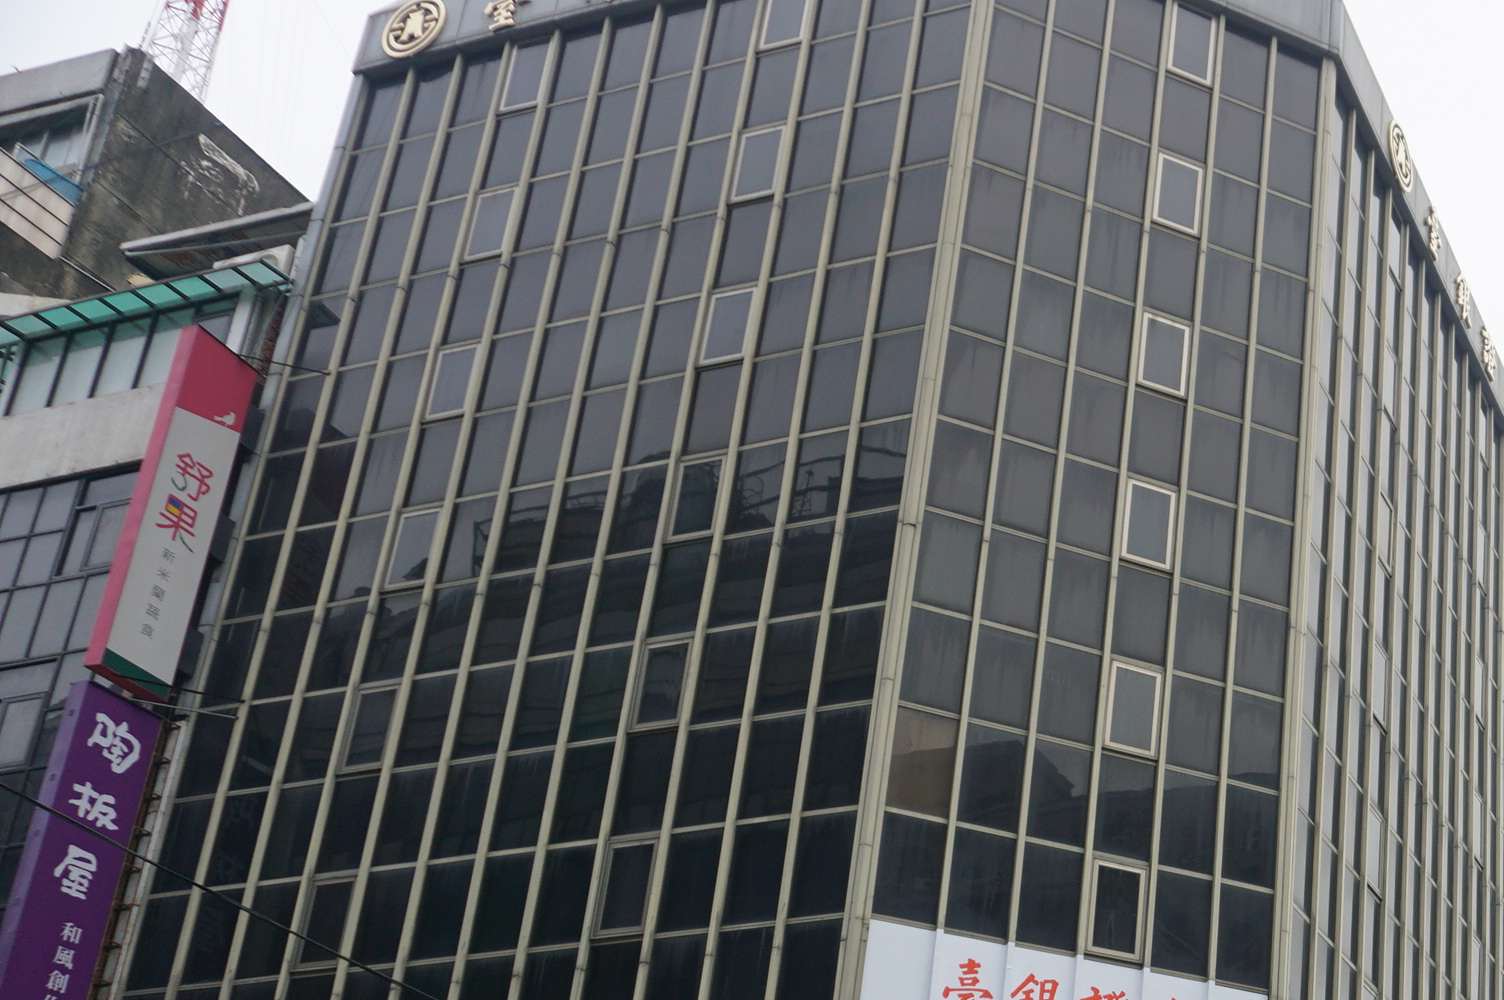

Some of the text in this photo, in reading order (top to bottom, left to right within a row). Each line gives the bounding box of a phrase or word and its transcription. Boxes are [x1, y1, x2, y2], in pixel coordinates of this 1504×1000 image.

[155, 452, 214, 554] 舒果
[54, 711, 141, 900] 陶板屋
